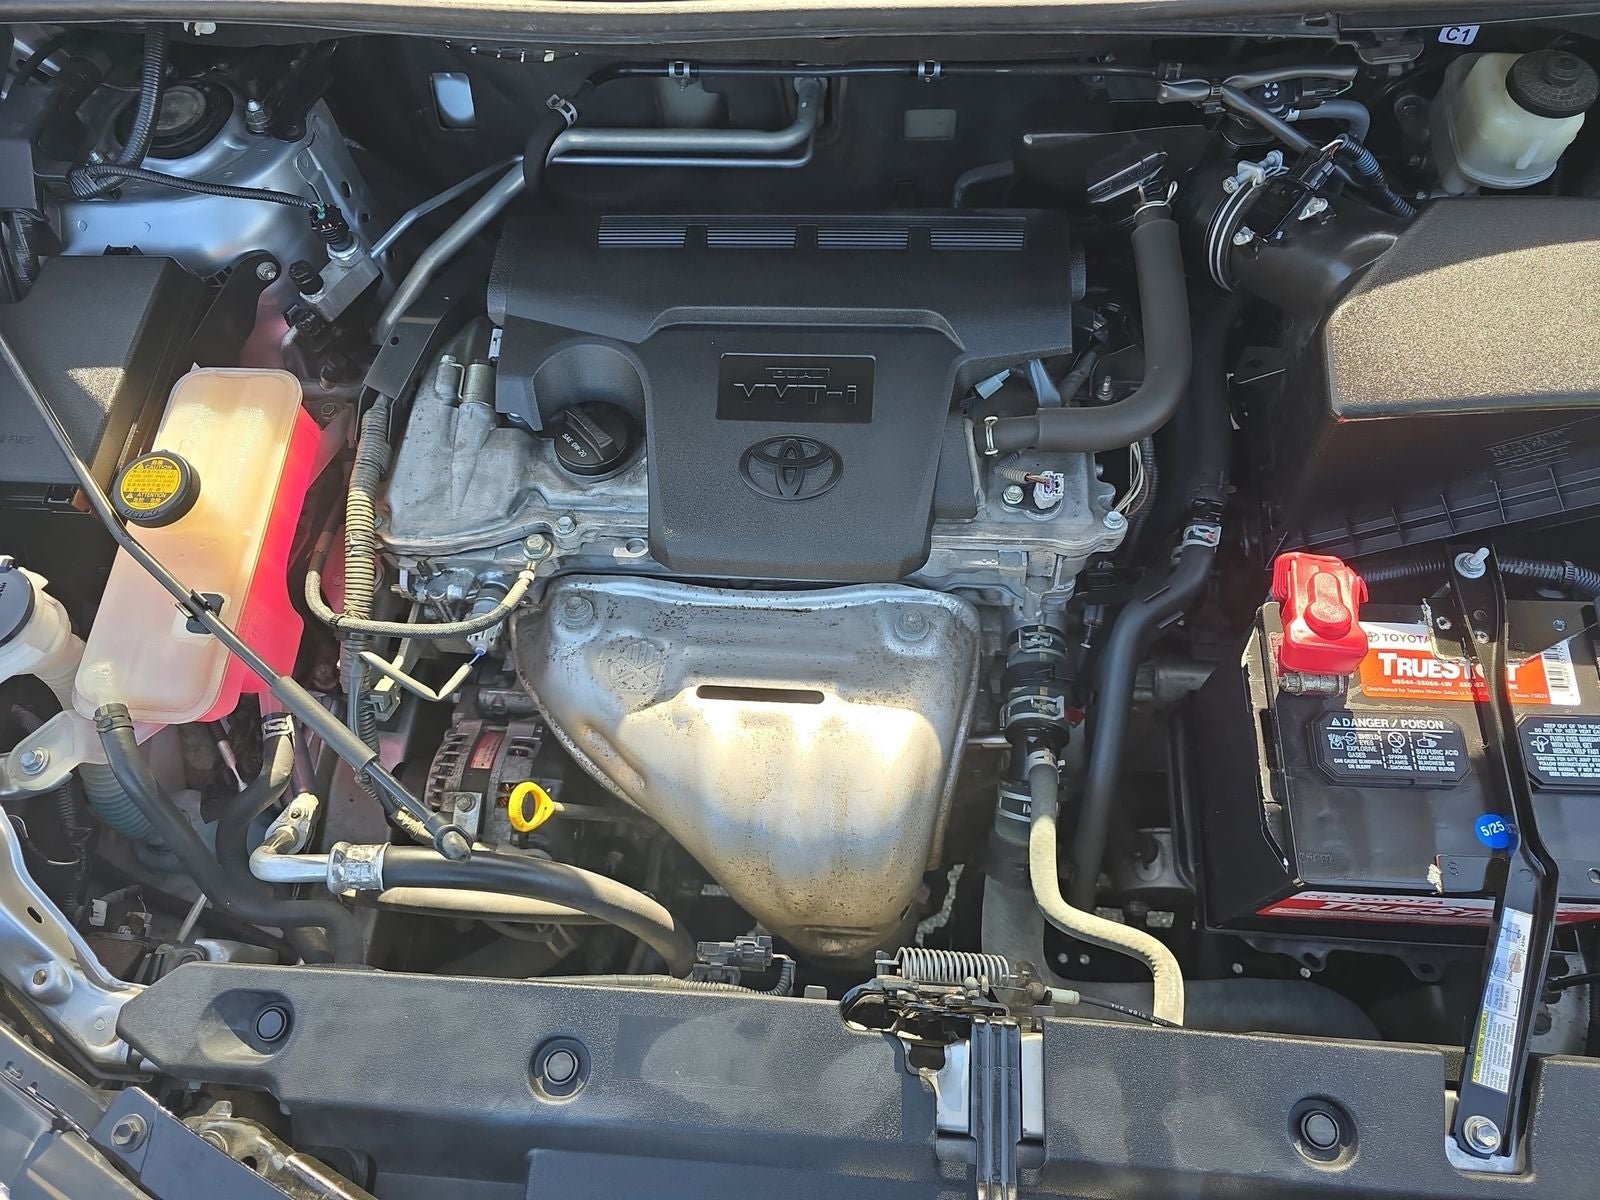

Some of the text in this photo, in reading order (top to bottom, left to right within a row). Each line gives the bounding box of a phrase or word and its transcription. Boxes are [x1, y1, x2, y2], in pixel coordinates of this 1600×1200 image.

[1446, 27, 1470, 43] C1
[561, 433, 574, 444] SAE
[1341, 718, 1390, 728] DANGER
[1400, 719, 1445, 730] POISON
[1346, 745, 1378, 753] EXPLOSIVE
[1415, 748, 1459, 757] SULFURIC ACID
[1347, 751, 1367, 759] GASES
[1480, 820, 1505, 837] 5/25
